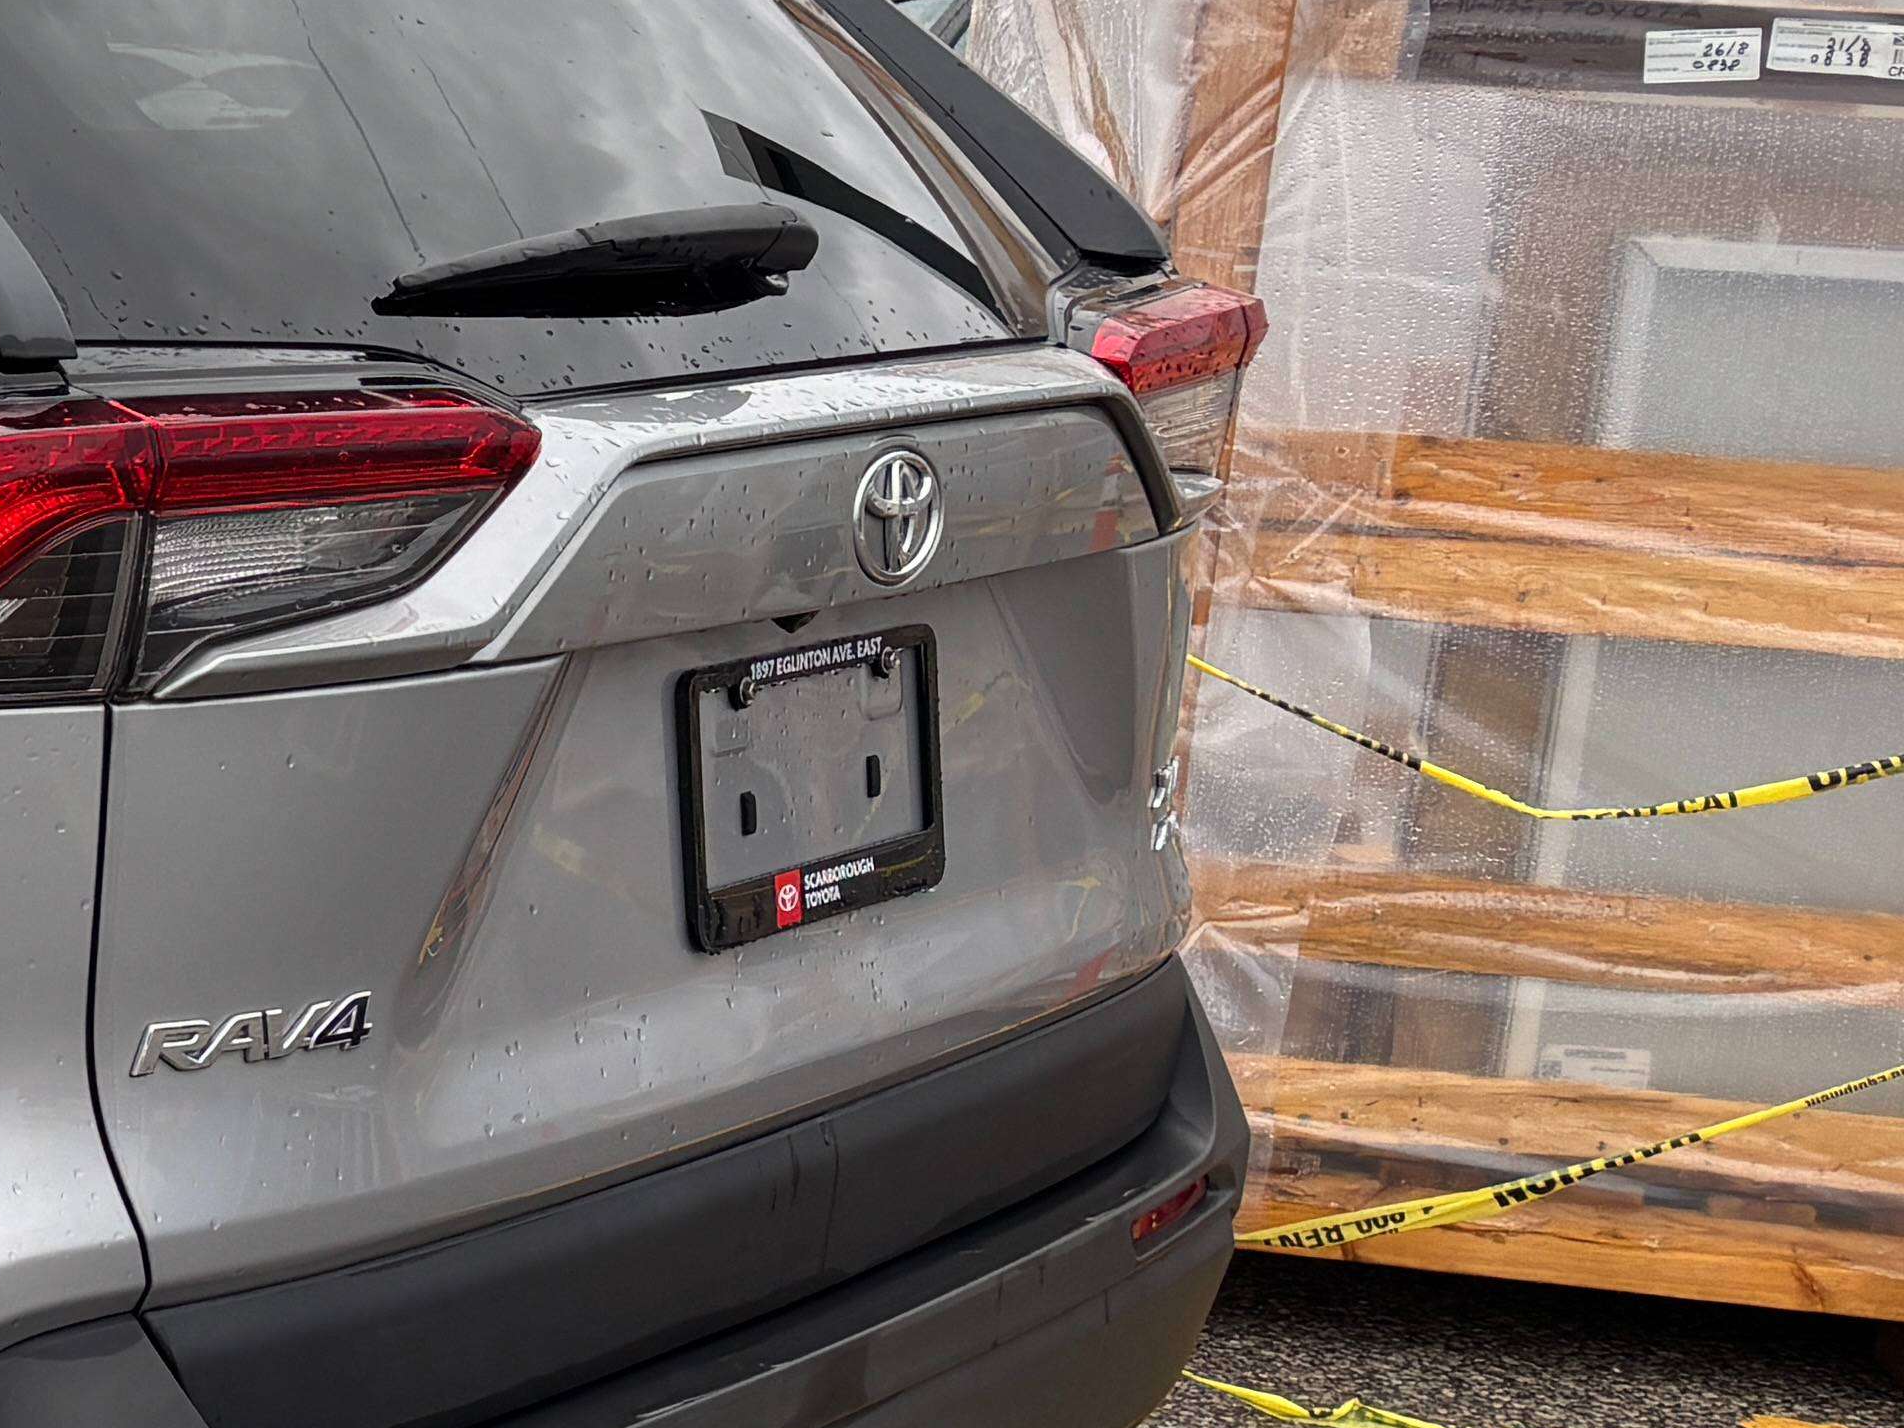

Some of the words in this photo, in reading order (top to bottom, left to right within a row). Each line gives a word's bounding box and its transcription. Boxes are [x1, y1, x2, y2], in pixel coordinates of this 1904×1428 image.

[750, 659, 775, 681] 1897
[776, 649, 832, 676] EGLINTON
[857, 635, 883, 659] EAST
[803, 856, 875, 891] SCARBOROUGH
[804, 884, 842, 910] TOYOTA
[128, 989, 374, 1078] RAV4
